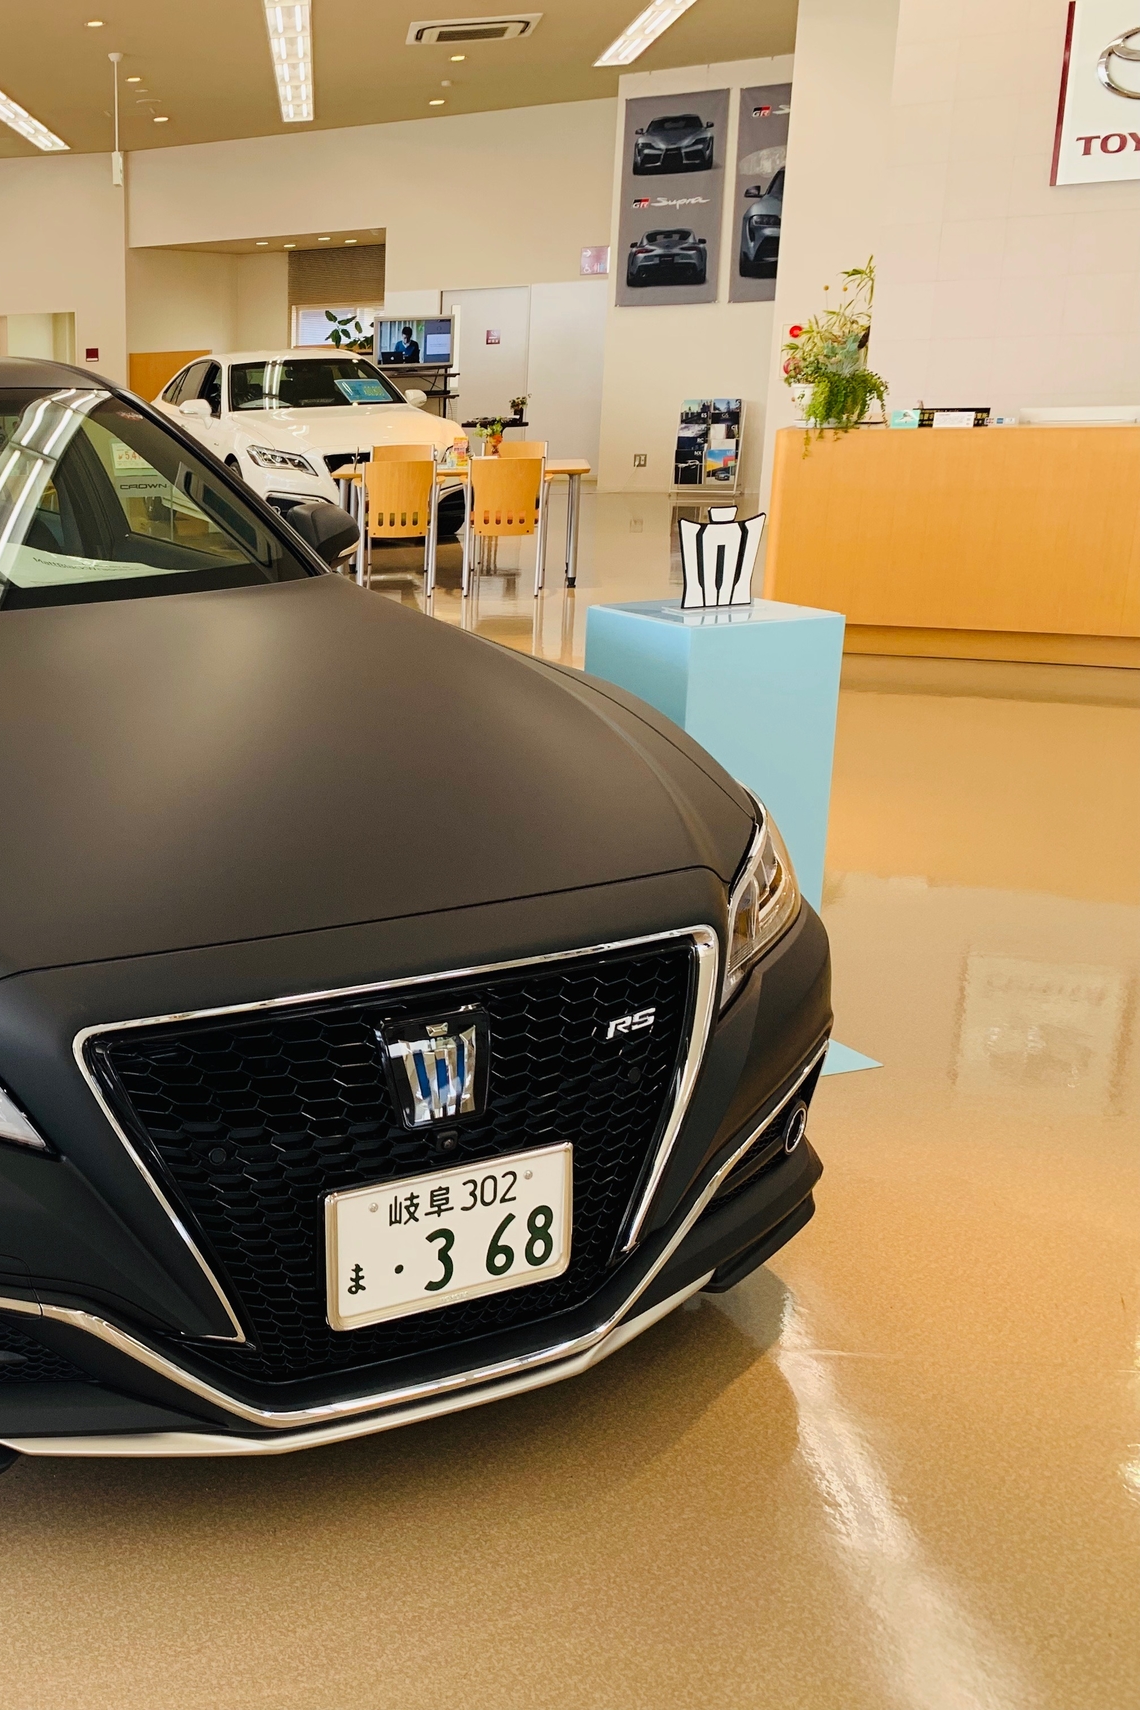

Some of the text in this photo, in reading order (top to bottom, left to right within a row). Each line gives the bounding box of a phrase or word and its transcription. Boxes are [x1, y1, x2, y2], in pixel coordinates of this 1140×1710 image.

[632, 196, 710, 209] GR Supra
[606, 1007, 657, 1040] RS
[388, 1170, 518, 1227] 岐阜 302
